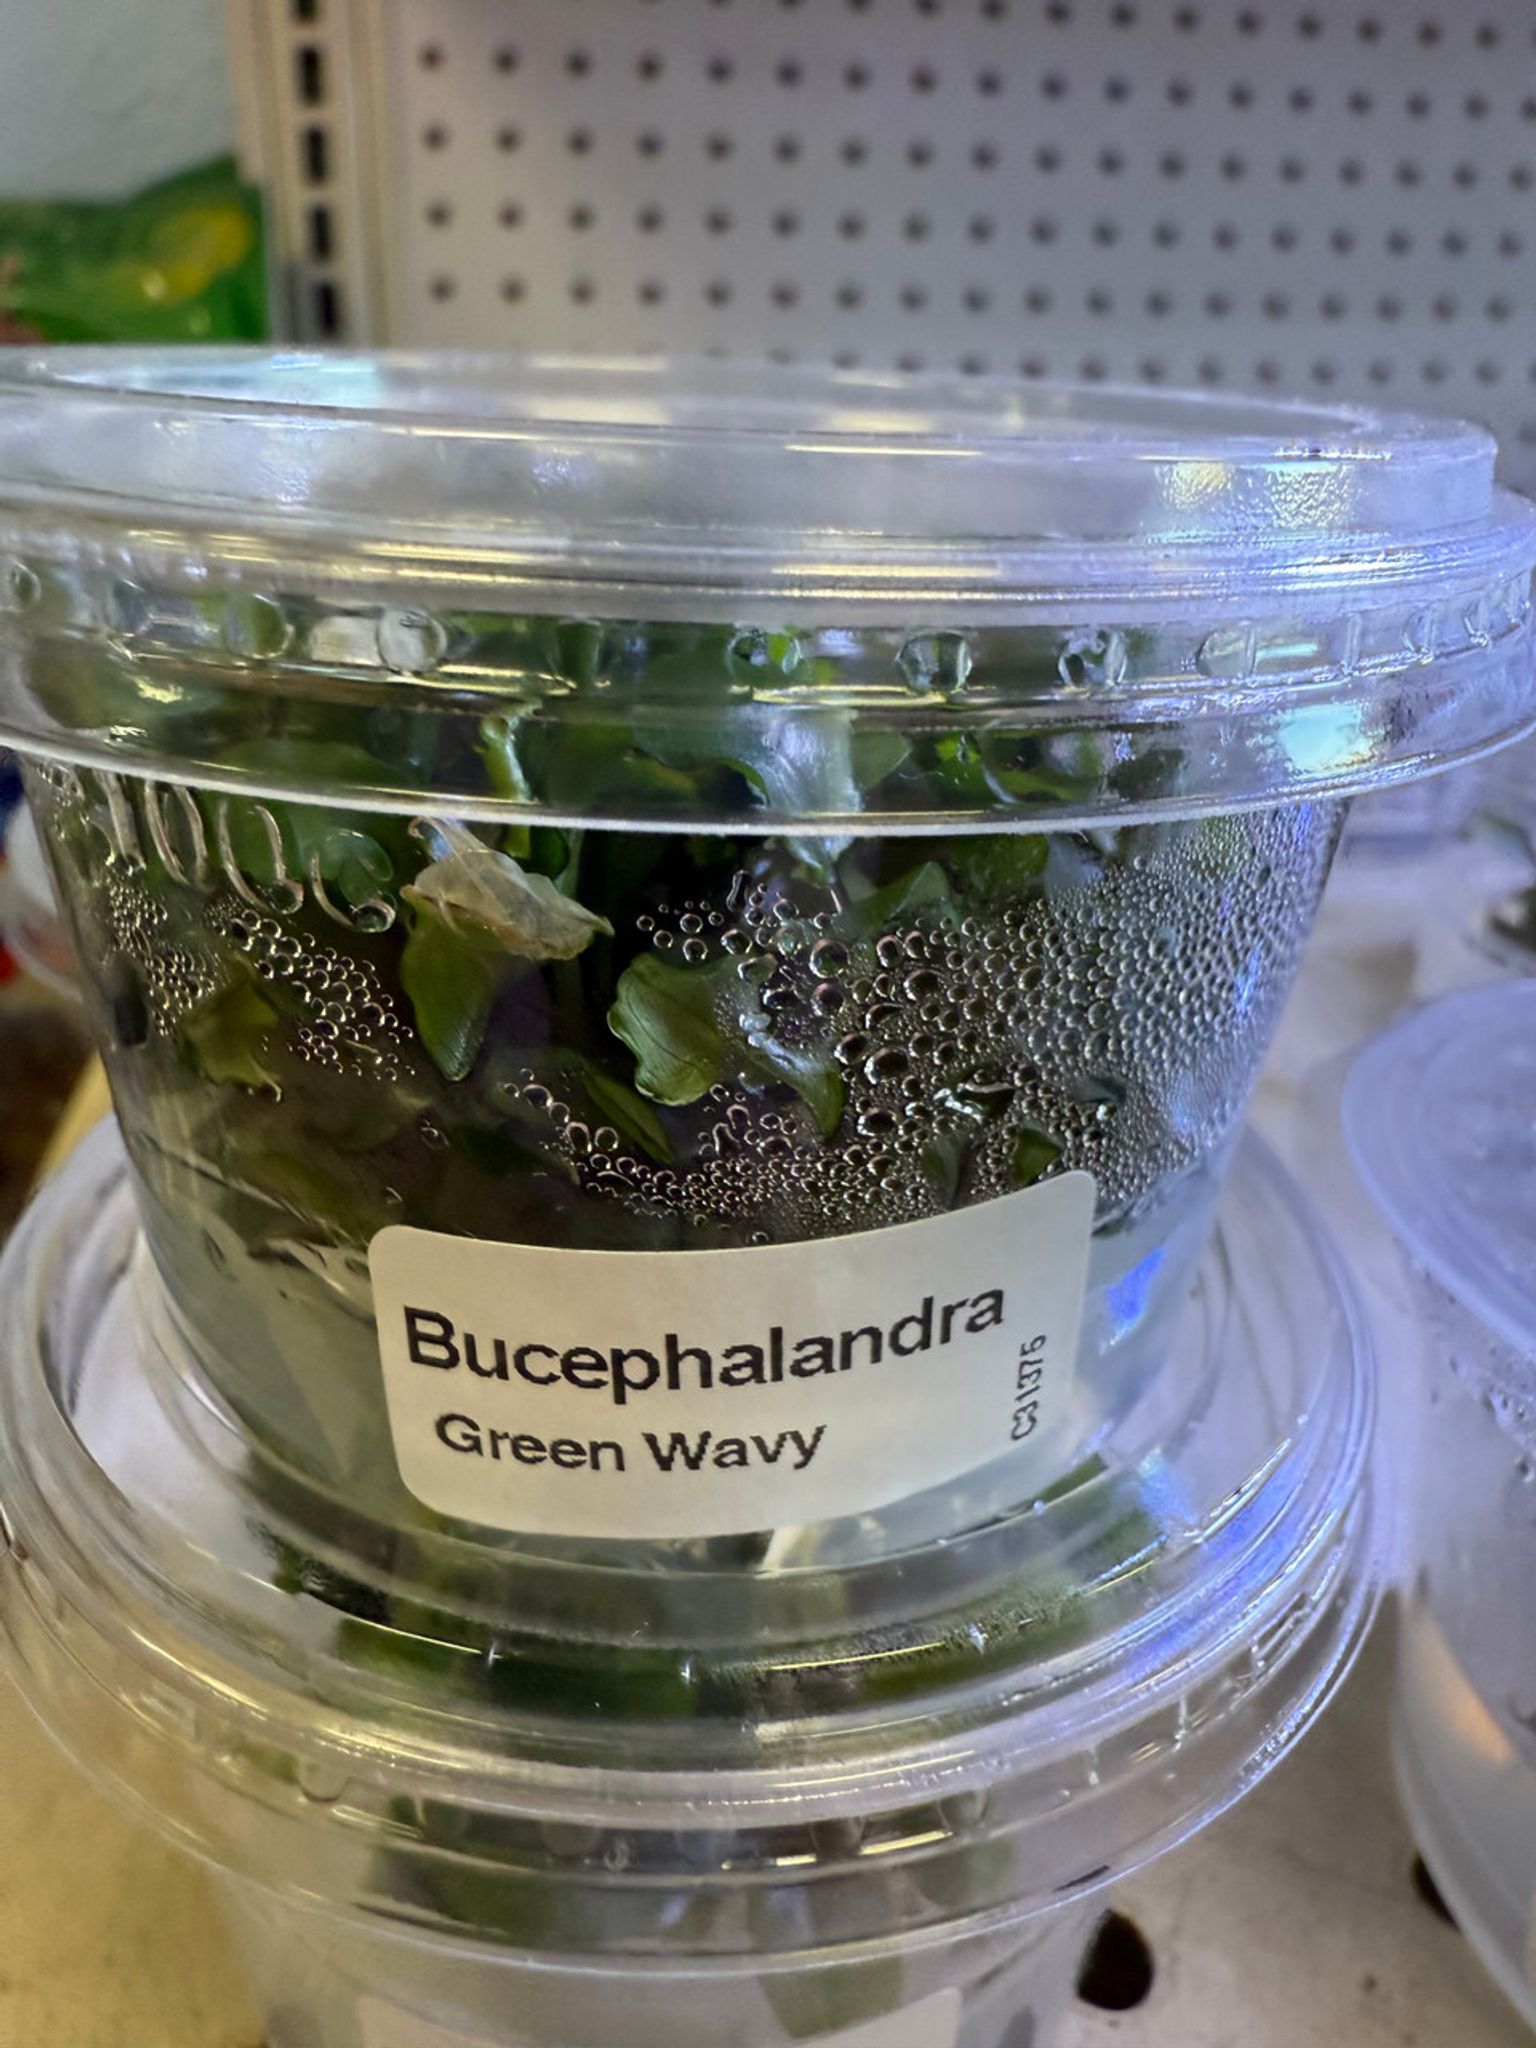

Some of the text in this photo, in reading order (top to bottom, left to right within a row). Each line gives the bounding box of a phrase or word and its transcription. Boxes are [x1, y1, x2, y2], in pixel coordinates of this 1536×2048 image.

[403, 1288, 1005, 1405] Bucephalandra
[434, 1412, 828, 1473] Green Wavy
